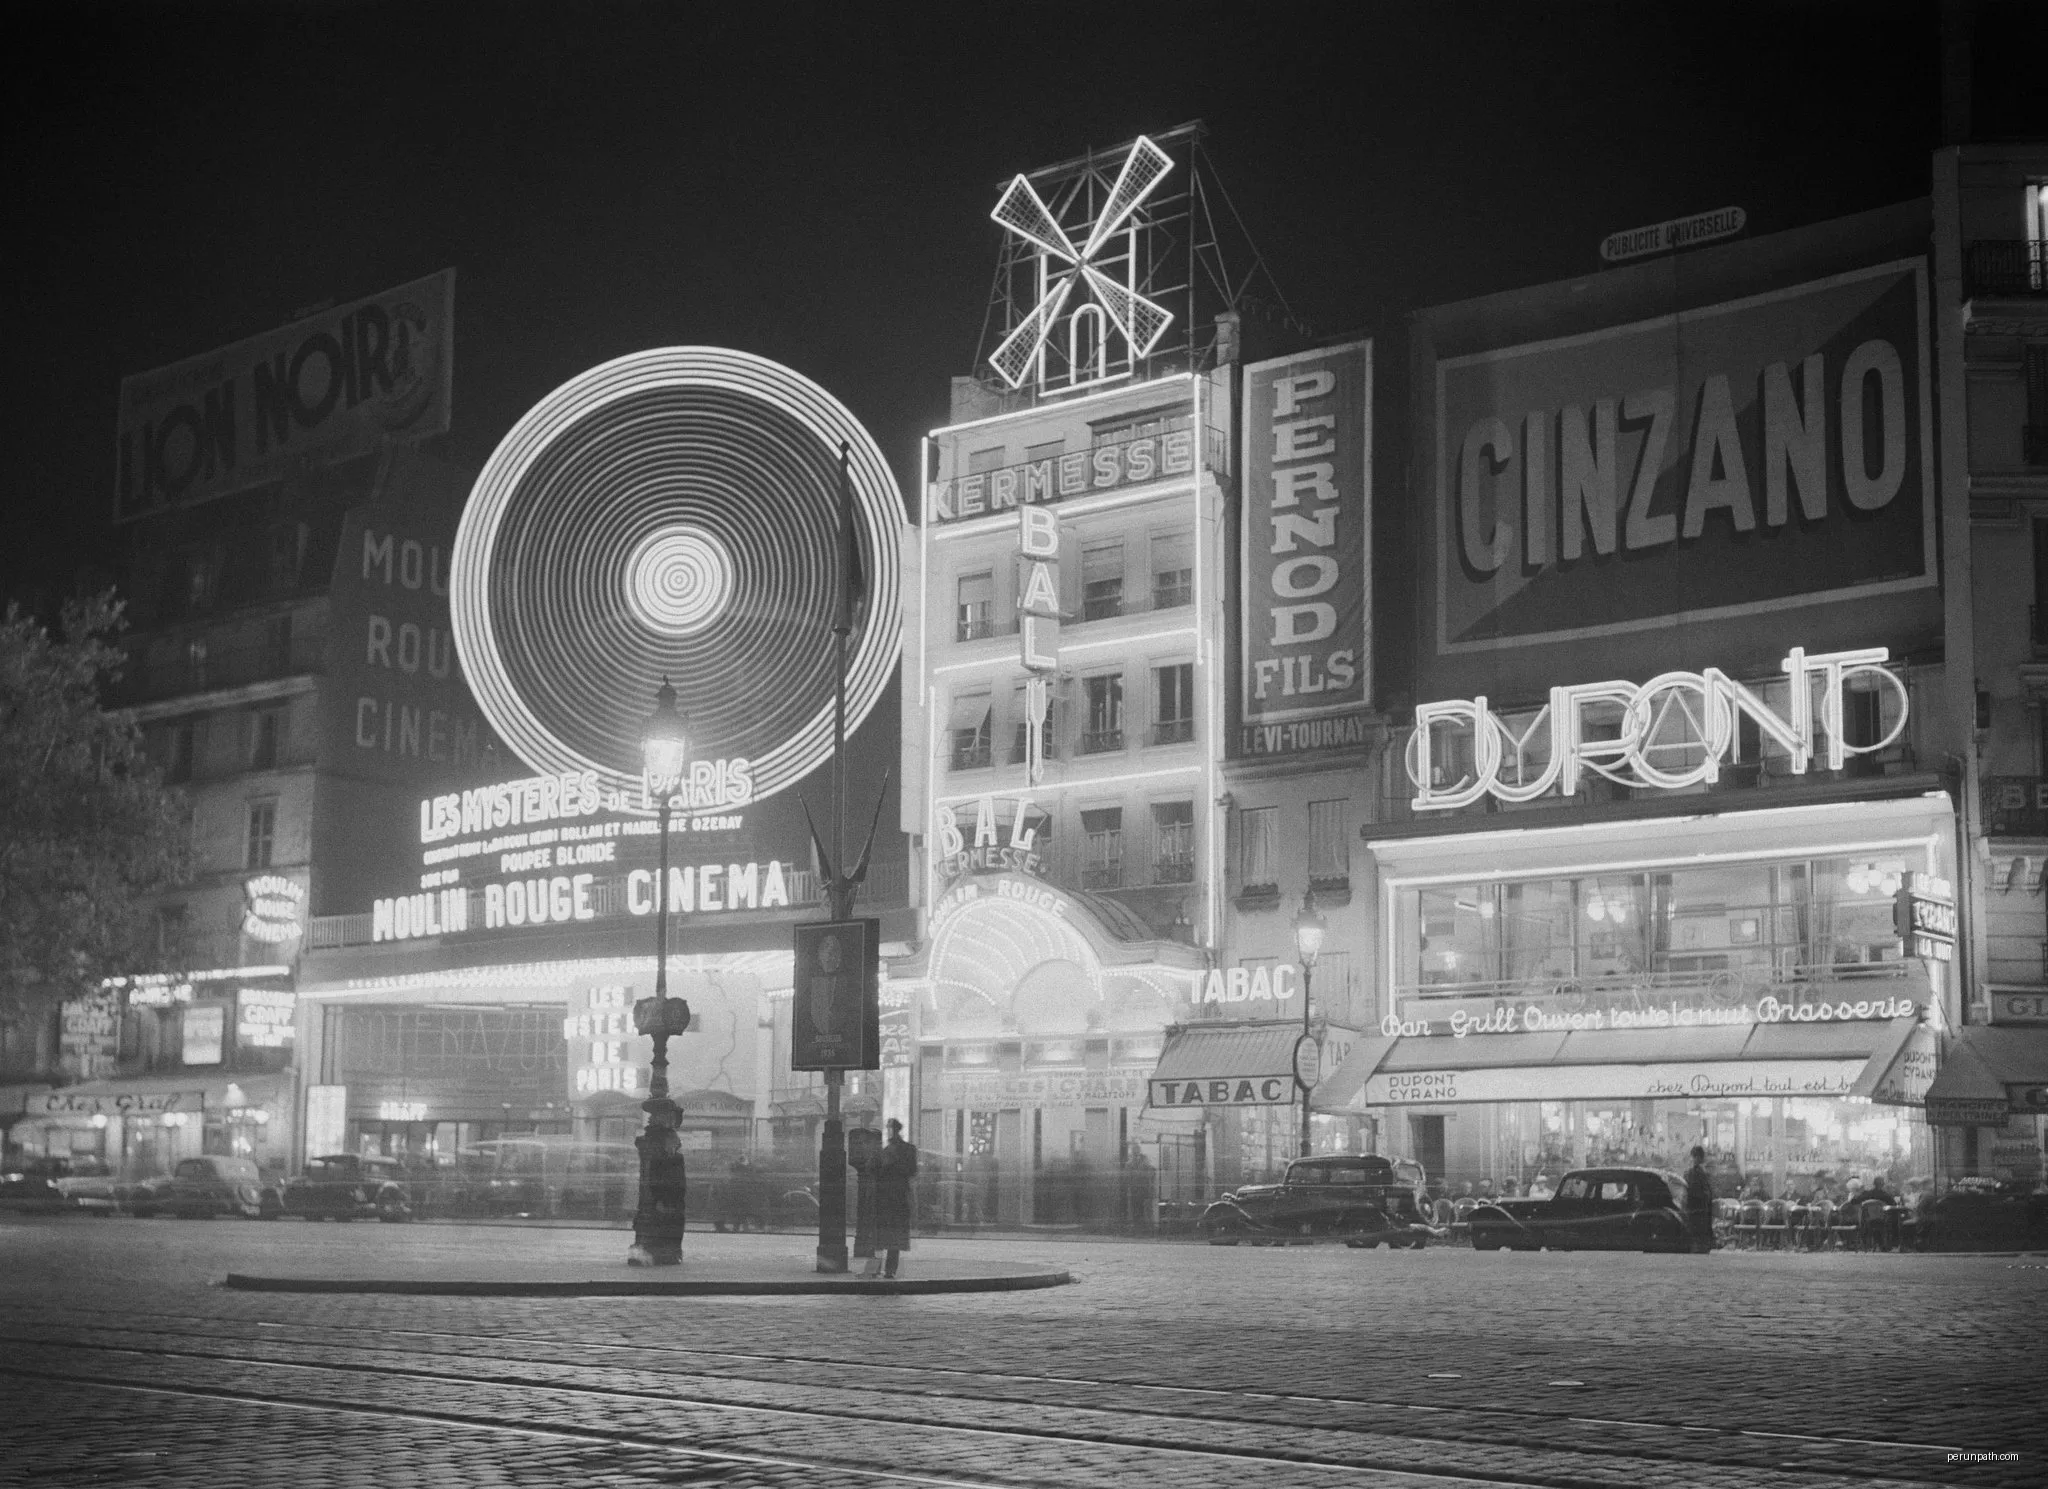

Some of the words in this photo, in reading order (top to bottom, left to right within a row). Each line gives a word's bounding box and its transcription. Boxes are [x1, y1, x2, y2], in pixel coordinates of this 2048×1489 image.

[1665, 210, 1738, 245] UNIVERSELLE
[120, 378, 238, 515] LION
[253, 303, 396, 456] NOIR
[928, 430, 1194, 523] KERMESSE
[1458, 339, 1907, 575] CINZANO
[1270, 370, 1341, 647] PERNOD
[1021, 505, 1059, 671] BAL
[1254, 648, 1356, 700] FILS
[1411, 647, 1889, 811] DUPONT
[420, 793, 462, 844] LES
[462, 769, 601, 834] MYSTERES
[607, 791, 631, 811] DE
[641, 757, 753, 811] PARIS
[939, 796, 1035, 858] BAL
[556, 841, 617, 867] BLONDE
[248, 875, 304, 901] MOULIN
[372, 888, 468, 943] MOULIN
[485, 873, 595, 930] ROUGE
[627, 859, 790, 917] CINEMA
[998, 878, 1070, 918] ROUGE
[588, 985, 625, 1009] LES
[1188, 963, 1295, 1005] TABAC
[1381, 1014, 1432, 1037] Bar
[1450, 1006, 1519, 1039] Grill
[1523, 1006, 1604, 1031] Ouvert
[1757, 996, 1915, 1023] Brasserie
[576, 1067, 637, 1093] PARIS
[1159, 1078, 1282, 1105] TABAC
[1388, 1087, 1458, 1101] CYRANO
[1389, 1074, 1457, 1088] DUPONT
